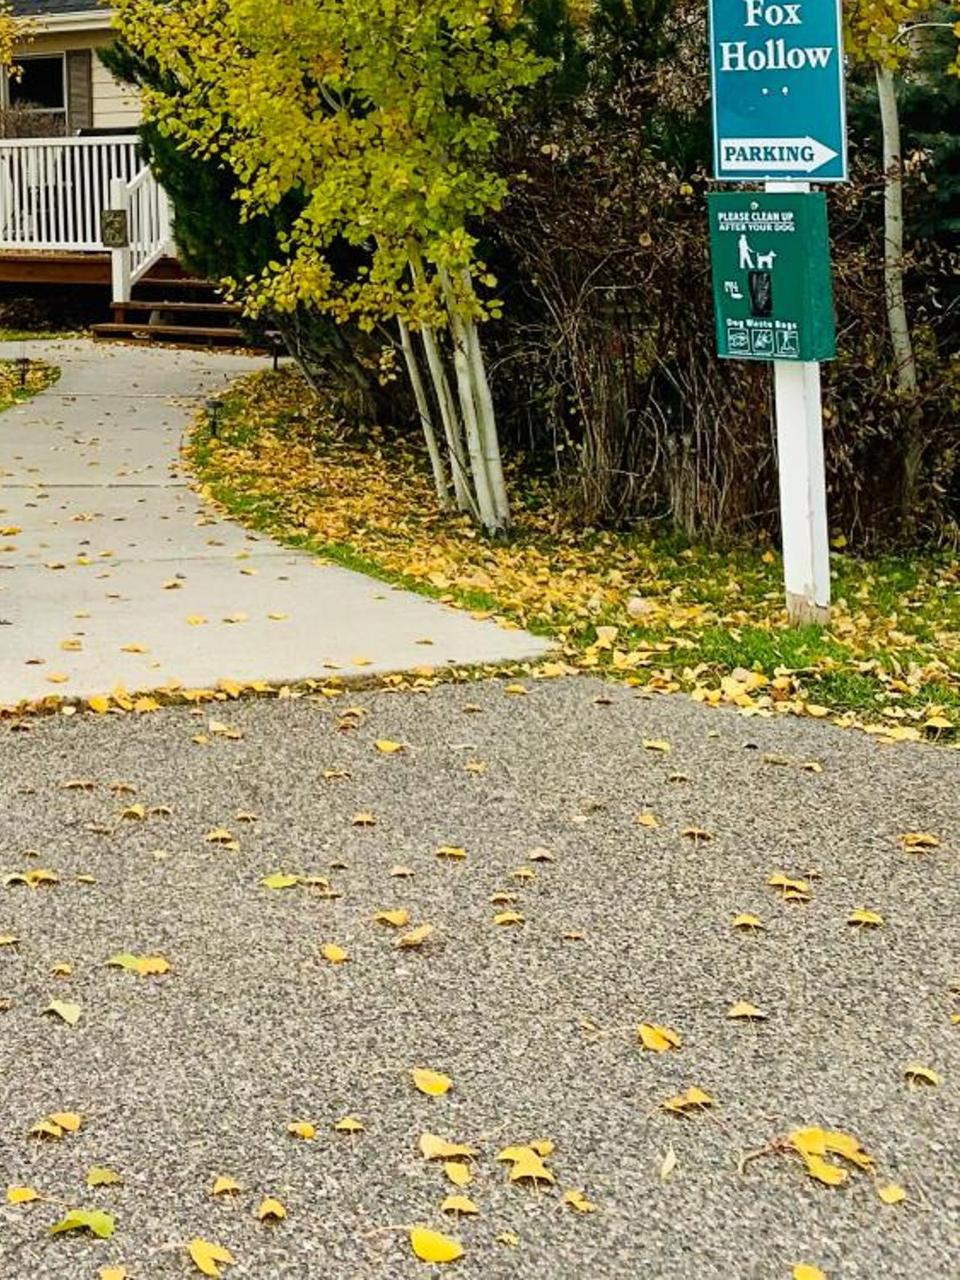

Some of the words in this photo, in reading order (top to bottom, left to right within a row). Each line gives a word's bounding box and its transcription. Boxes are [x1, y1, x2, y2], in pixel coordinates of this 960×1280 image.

[719, 38, 833, 71] Hollow
[724, 146, 814, 163] PARKING
[717, 212, 749, 221] PLEASE
[751, 212, 779, 221] CLEAN
[781, 212, 794, 221] UP
[718, 222, 746, 231] AFTER
[748, 222, 772, 231] YOUR
[774, 222, 795, 232] DOG
[726, 318, 744, 329] Dog
[745, 319, 773, 329] Waste
[775, 320, 797, 331] Bags
